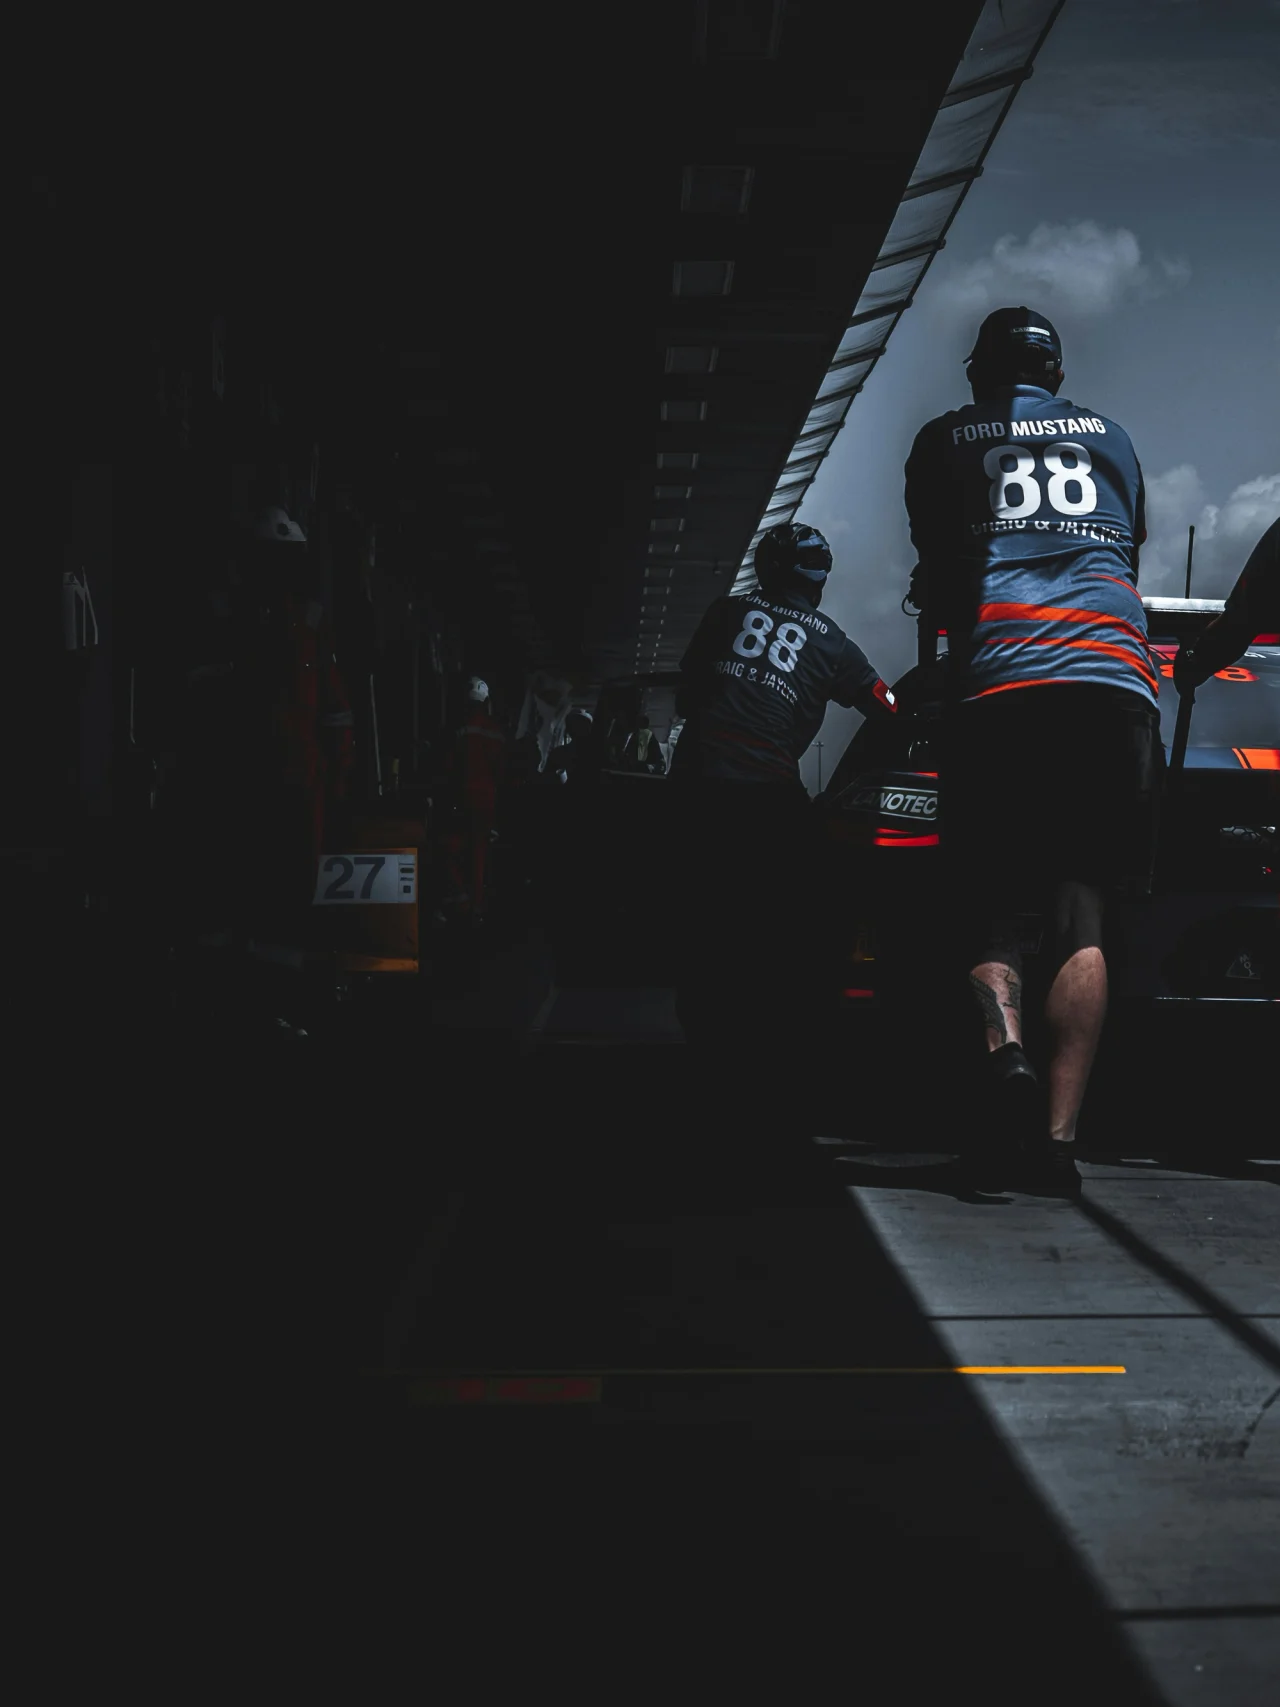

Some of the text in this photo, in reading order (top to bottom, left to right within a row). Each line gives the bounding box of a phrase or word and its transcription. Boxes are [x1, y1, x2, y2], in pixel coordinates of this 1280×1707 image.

[953, 416, 1107, 446] FORD MUSTANG
[983, 441, 1098, 520] 88
[732, 610, 807, 673] 88
[747, 666, 757, 682] &
[323, 856, 385, 899] 27
